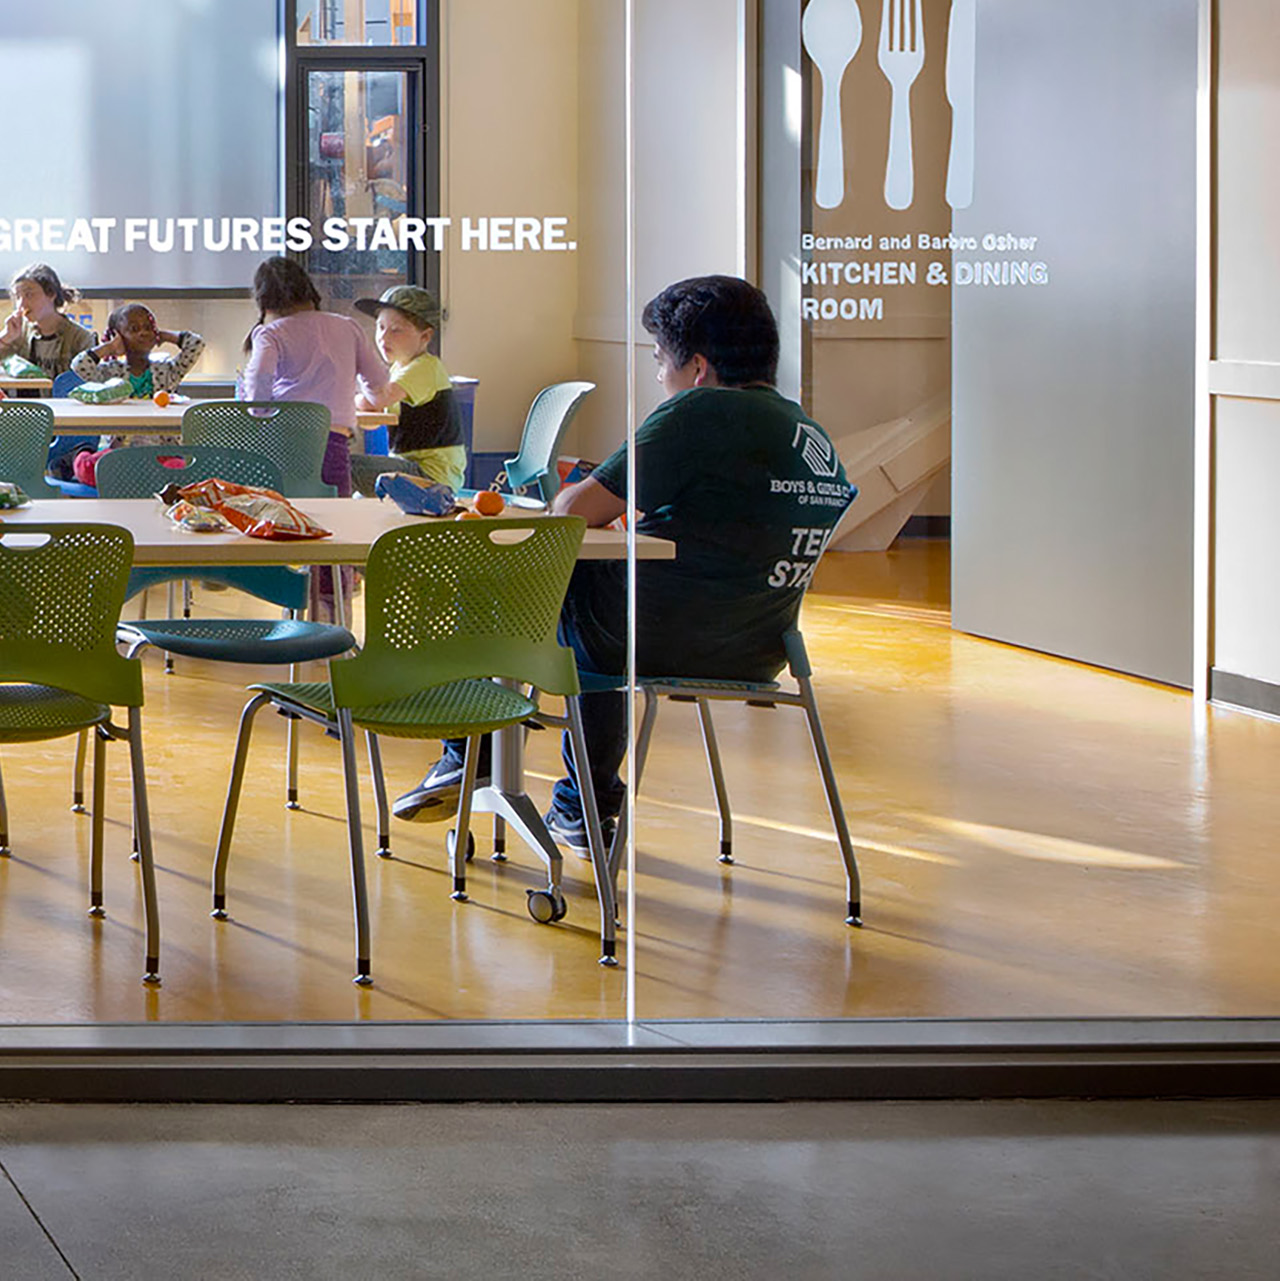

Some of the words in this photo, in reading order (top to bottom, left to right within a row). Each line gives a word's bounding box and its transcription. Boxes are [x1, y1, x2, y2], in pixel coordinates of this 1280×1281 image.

[124, 217, 314, 253] FUTURES
[321, 217, 452, 252] START
[461, 217, 578, 252] HERE.
[802, 233, 873, 250] Bernard
[879, 234, 911, 250] and
[801, 261, 917, 286] KITCHEN
[926, 261, 949, 286] &
[954, 261, 1049, 286] DINING
[801, 297, 884, 321] ROOM
[770, 479, 806, 494] BOYS
[807, 481, 816, 495] &
